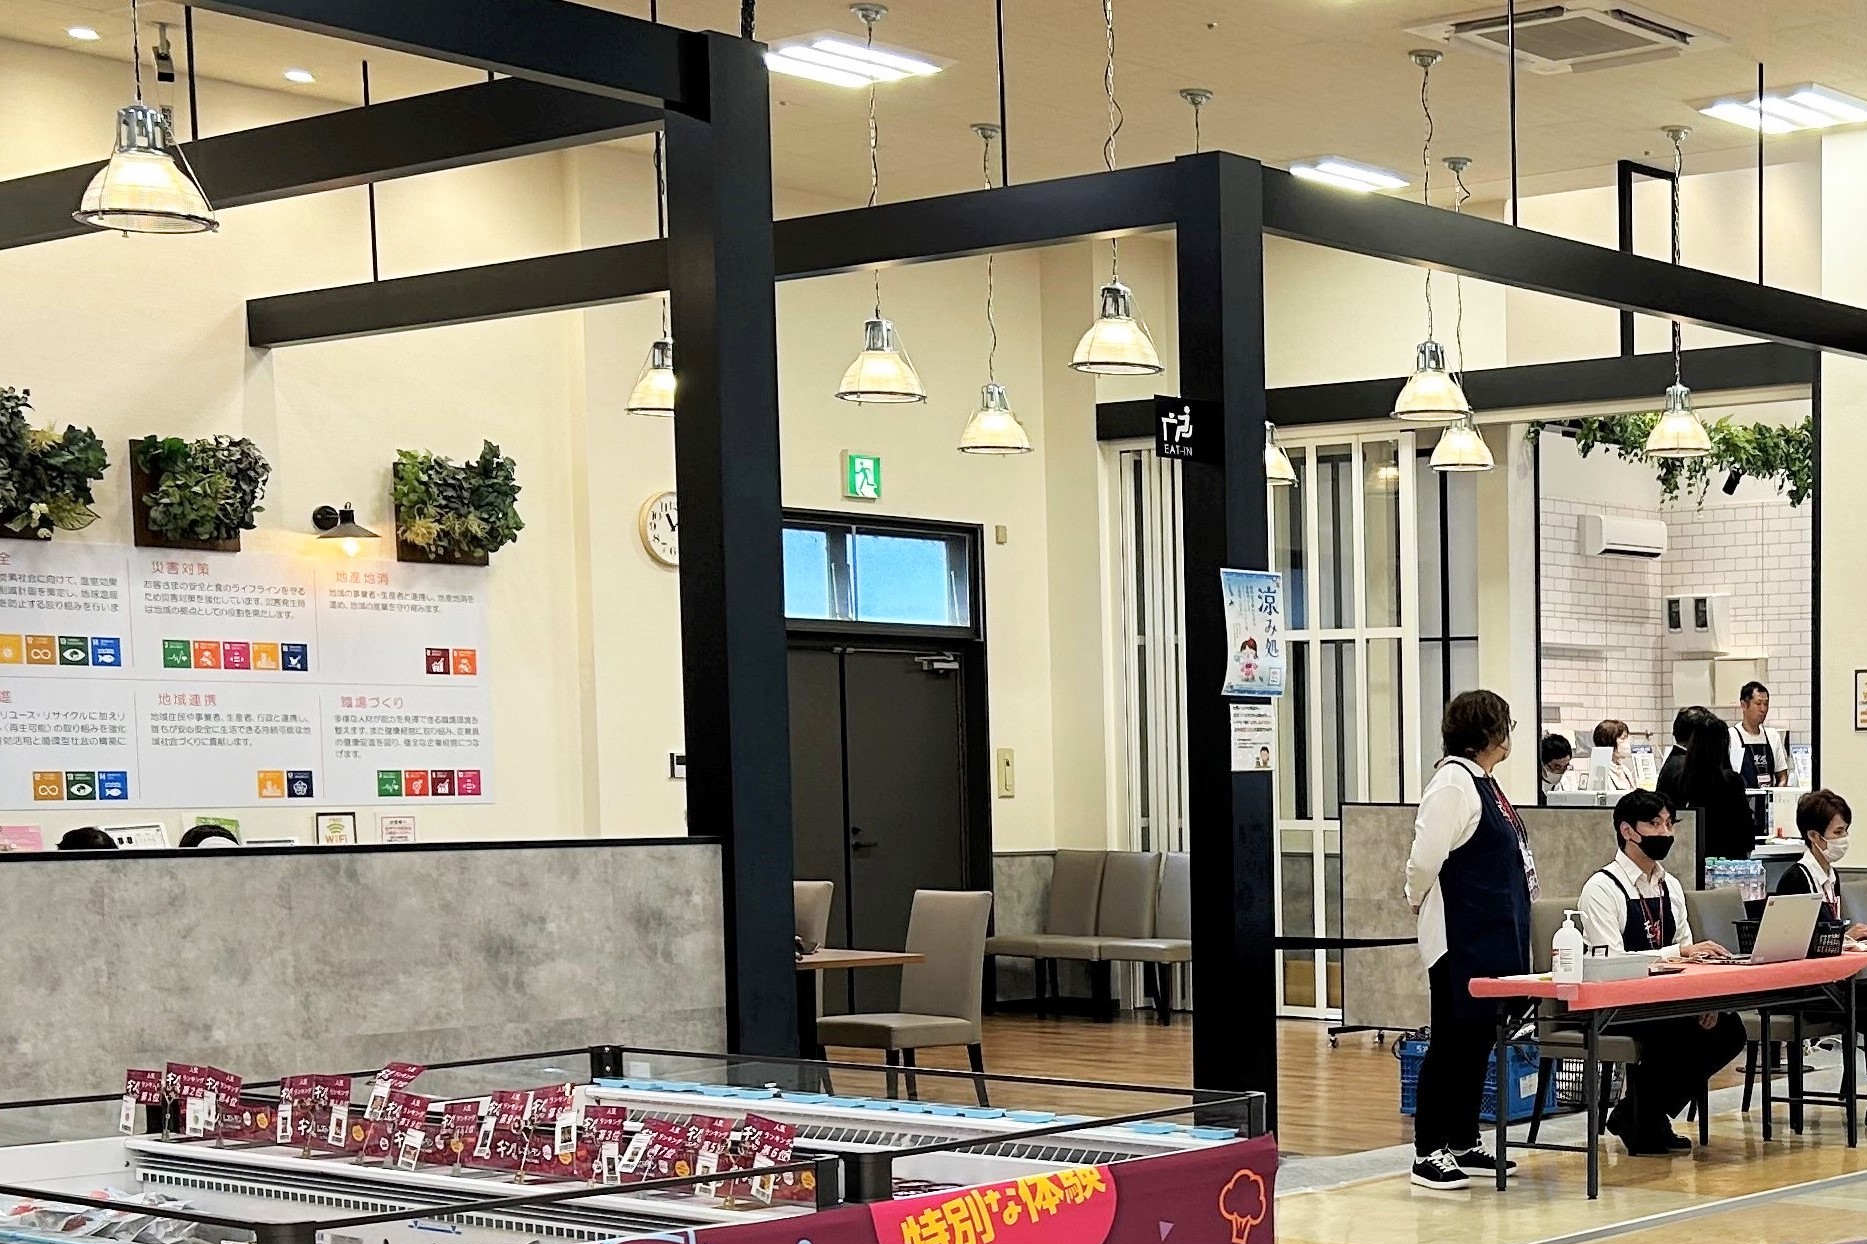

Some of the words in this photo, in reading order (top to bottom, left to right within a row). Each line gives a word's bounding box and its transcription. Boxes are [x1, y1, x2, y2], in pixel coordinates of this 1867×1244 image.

[1164, 443, 1193, 457] EAT-IN
[152, 560, 210, 577] 災害対策
[336, 571, 390, 586] 地産地消
[1257, 586, 1280, 658] 涼み処
[158, 693, 217, 707] 地域連携
[341, 696, 404, 709] 職場づくり
